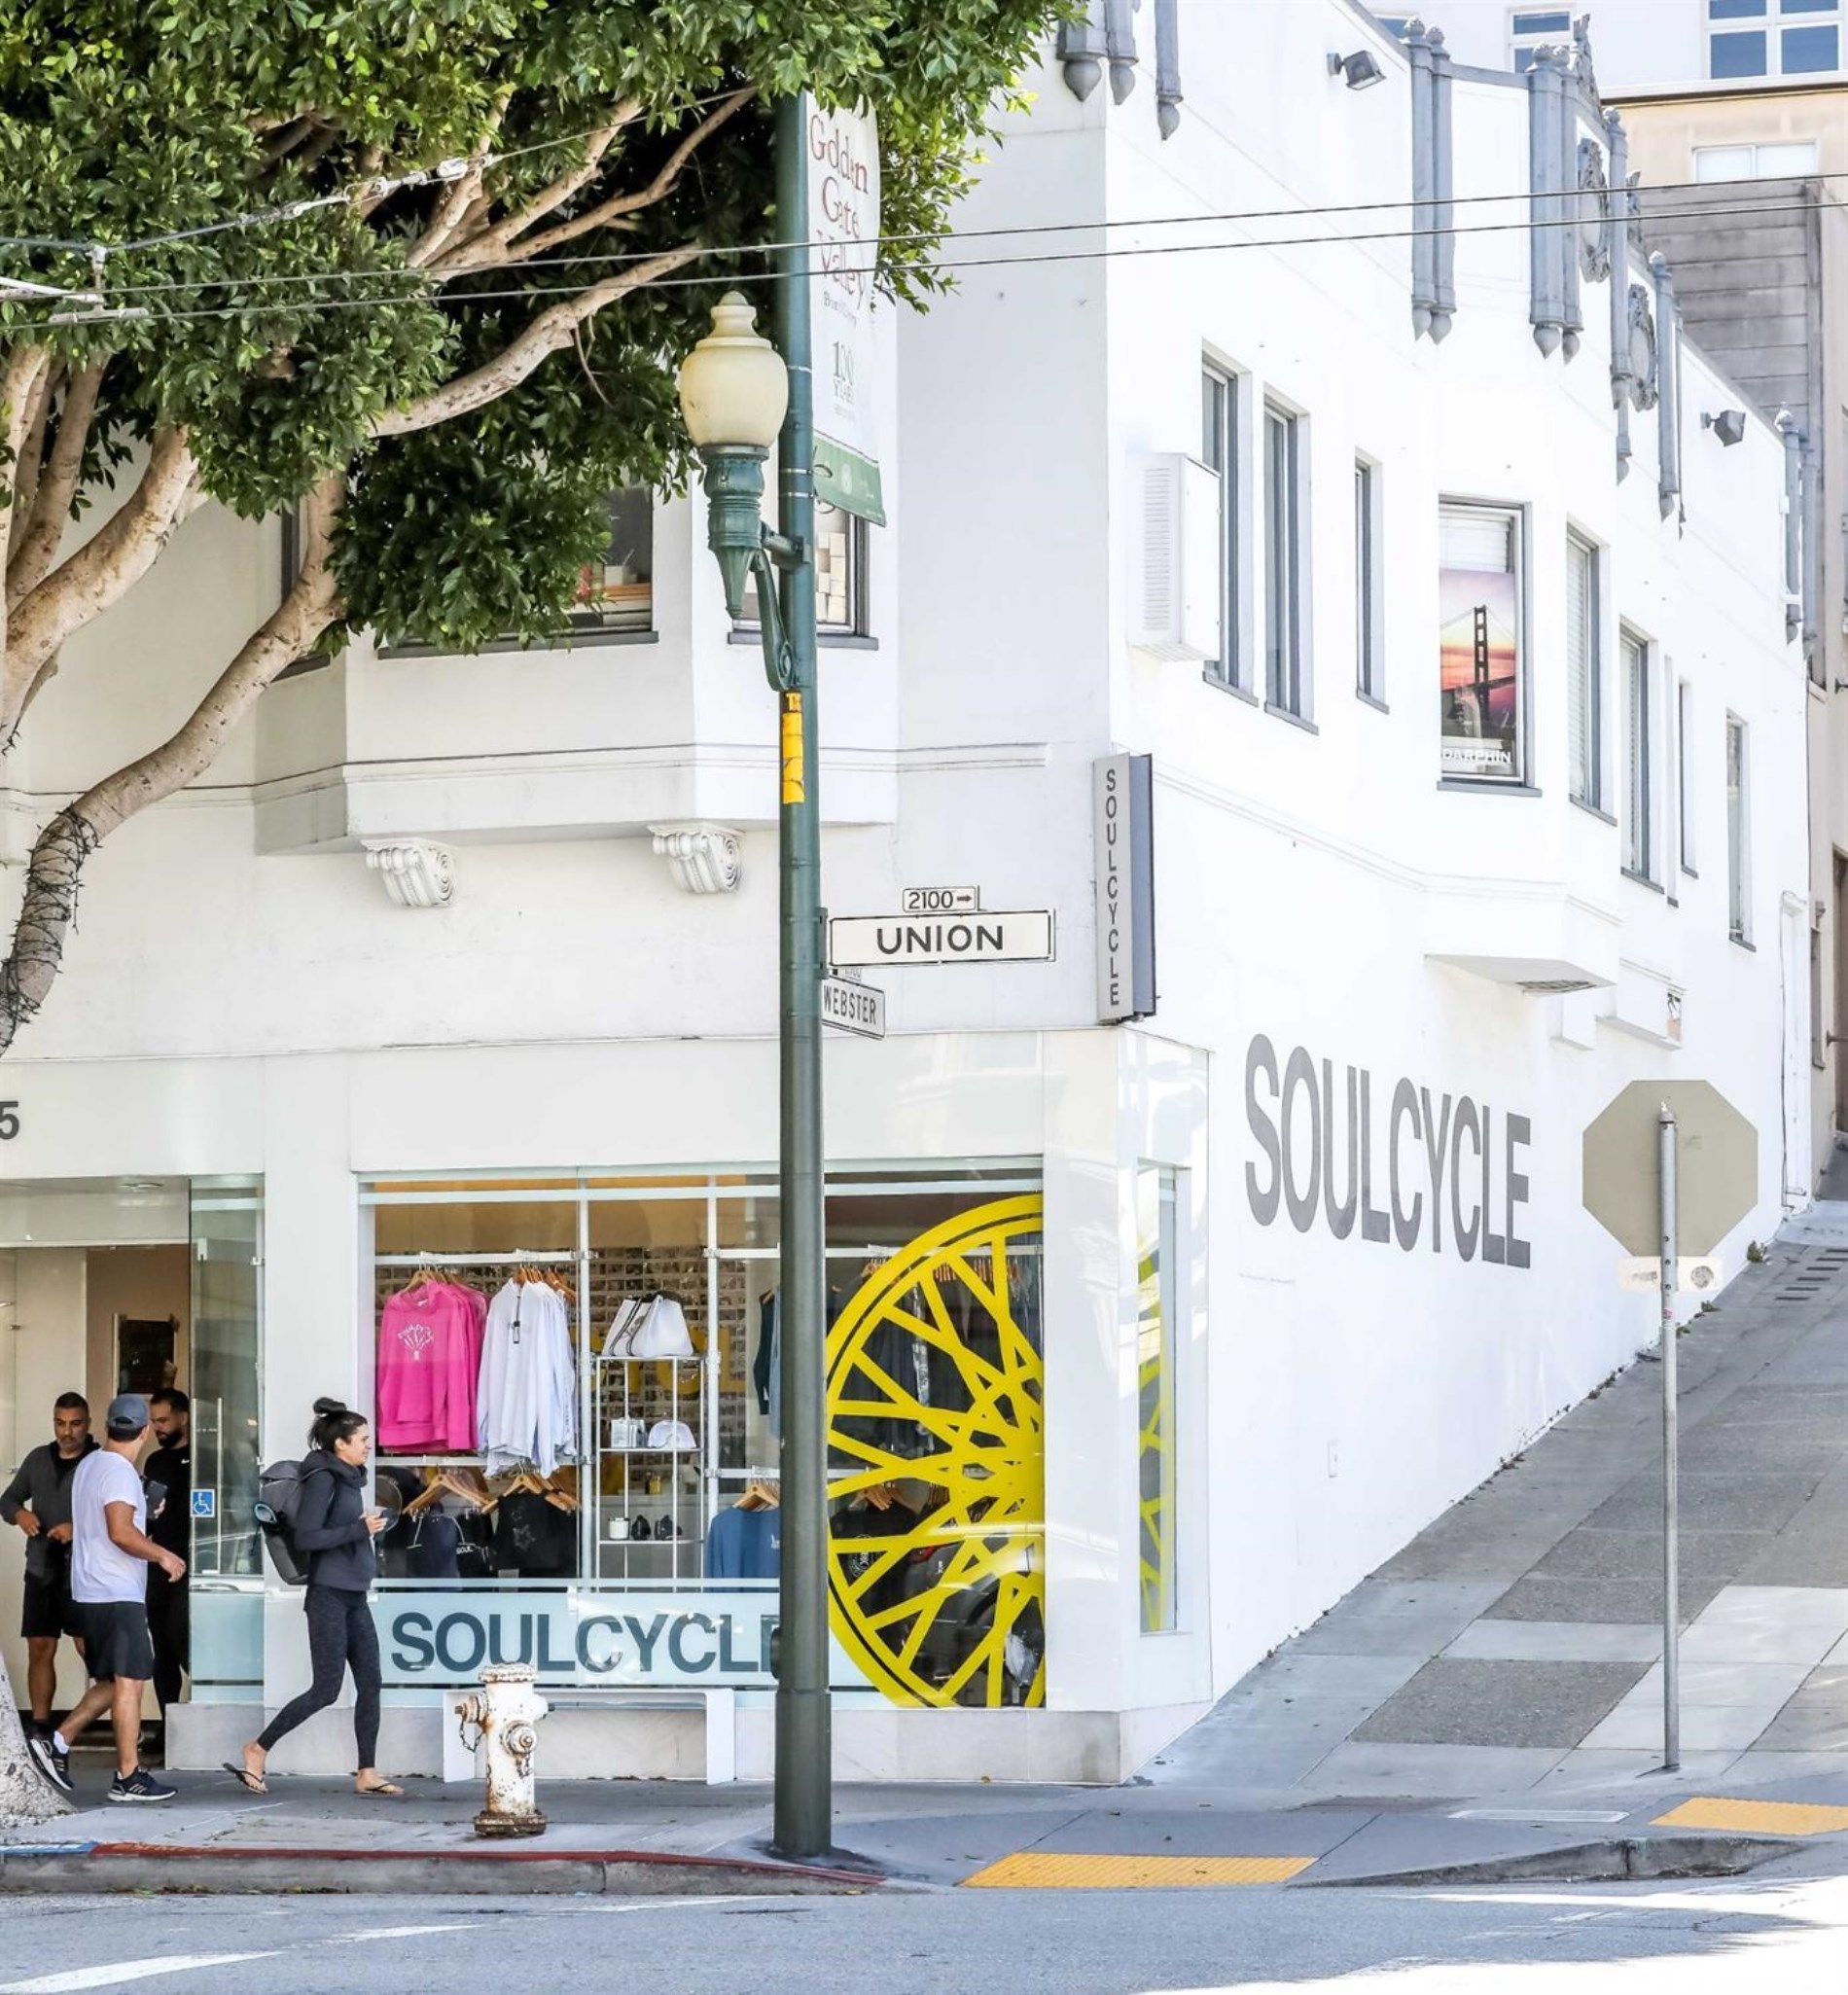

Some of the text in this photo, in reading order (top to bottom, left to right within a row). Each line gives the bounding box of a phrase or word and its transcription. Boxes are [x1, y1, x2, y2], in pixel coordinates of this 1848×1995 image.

[816, 229, 864, 310] Valley
[907, 891, 953, 910] 2100
[1106, 768, 1119, 1007] SOULCYCLE
[876, 924, 1004, 955] UNION
[824, 984, 876, 1025] WEBSTER
[0, 1100, 19, 1140] 5
[1245, 1033, 1531, 1269] SOULCYCLE
